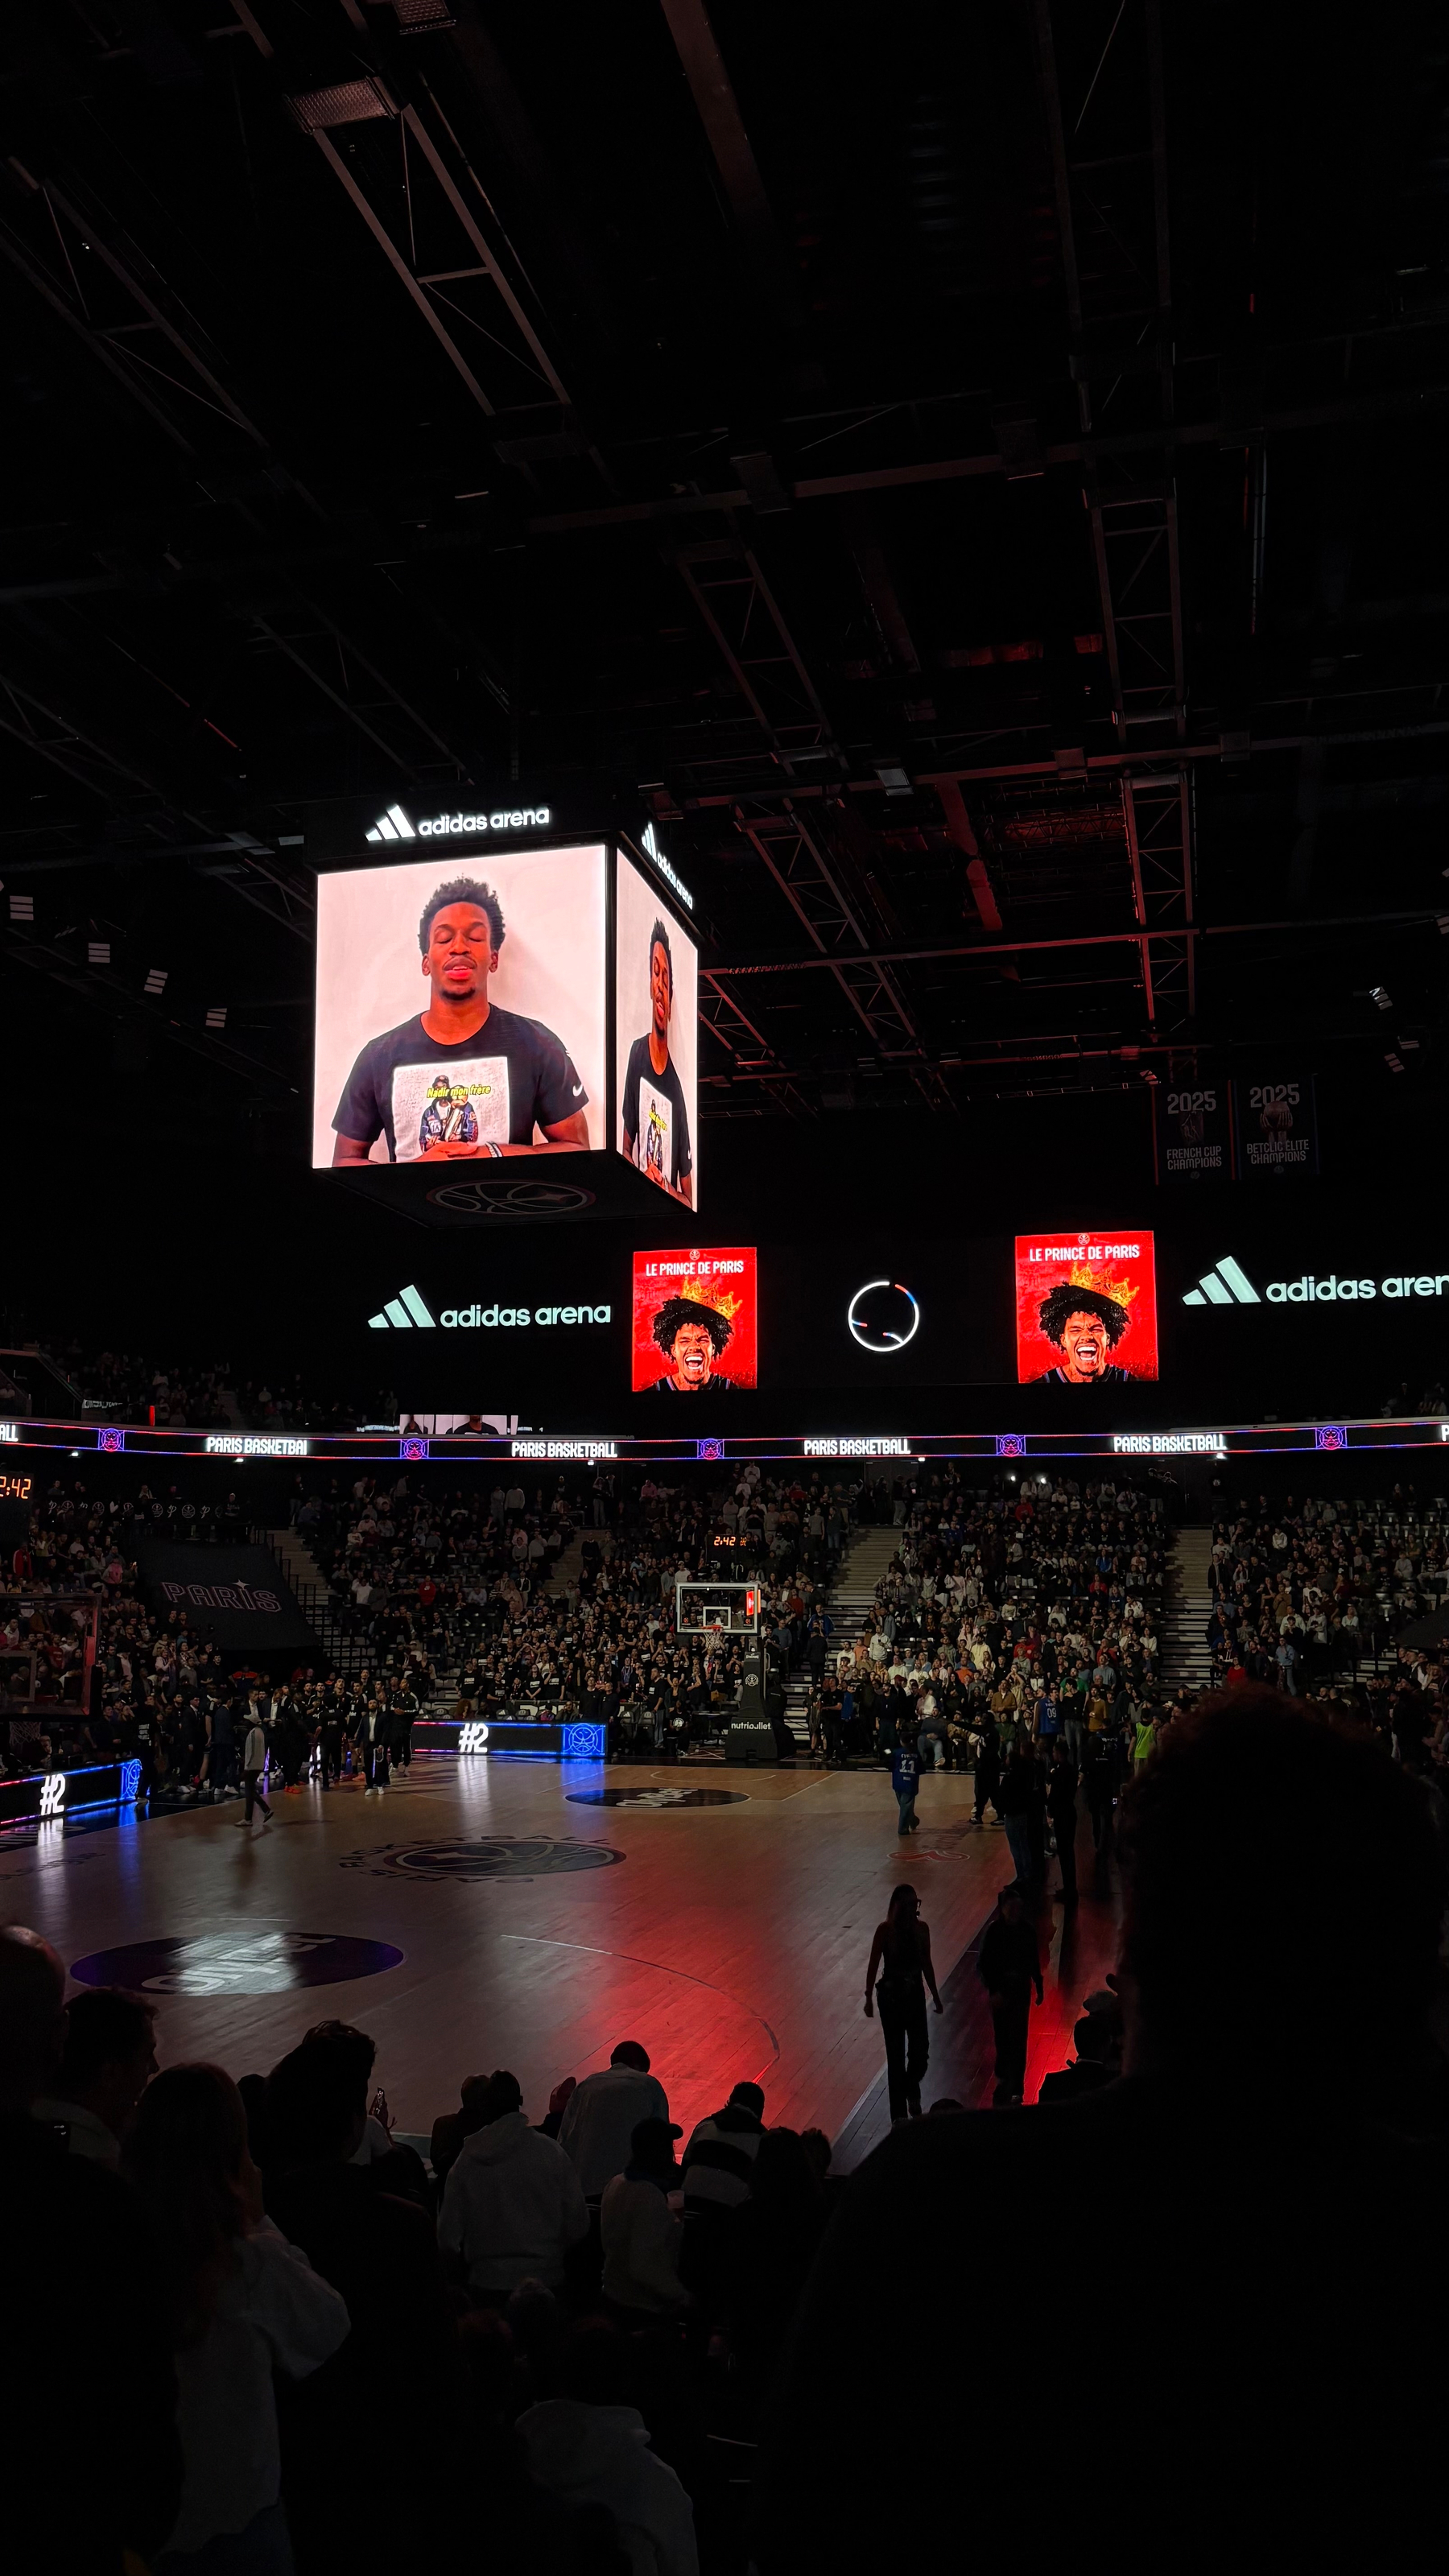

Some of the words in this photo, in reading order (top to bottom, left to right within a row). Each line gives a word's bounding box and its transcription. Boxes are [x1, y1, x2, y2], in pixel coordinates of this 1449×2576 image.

[418, 812, 488, 836] adidas
[489, 807, 550, 829] arena
[427, 1087, 451, 1098] Nadir
[451, 1087, 469, 1096] mon
[1249, 1084, 1301, 1108] 2025
[1167, 1090, 1217, 1114] 2025
[1166, 1147, 1200, 1159] FRENCH
[1203, 1146, 1221, 1157] CUP
[1246, 1141, 1284, 1154] BETCLIC
[1167, 1157, 1222, 1170] CHAMPIONS
[1250, 1150, 1307, 1165] CHAMPIONS
[1030, 1248, 1042, 1261] LE
[1045, 1247, 1086, 1261] PRINCE
[1088, 1246, 1103, 1260] DE
[1104, 1244, 1140, 1258] PARIS
[646, 1263, 658, 1277] LE
[659, 1261, 696, 1276] PRINCE
[697, 1261, 711, 1274] DE
[713, 1260, 744, 1274] PARIS
[1265, 1274, 1377, 1302] adidas
[440, 1304, 530, 1327] adidas
[535, 1305, 611, 1325] arena
[207, 1437, 242, 1454] PARIS
[511, 1442, 546, 1457] PARIS
[547, 1442, 618, 1458] BASKETBALL
[804, 1439, 838, 1455] PARIS
[840, 1439, 911, 1455] BASKETBALL
[1113, 1435, 1151, 1452] PARIS
[1152, 1433, 1228, 1451] BASKETBALL
[713, 1536, 736, 1546] 2:42
[159, 1581, 283, 1613] PARIS
[458, 1723, 489, 1753] #2
[39, 1773, 66, 1816] #2
